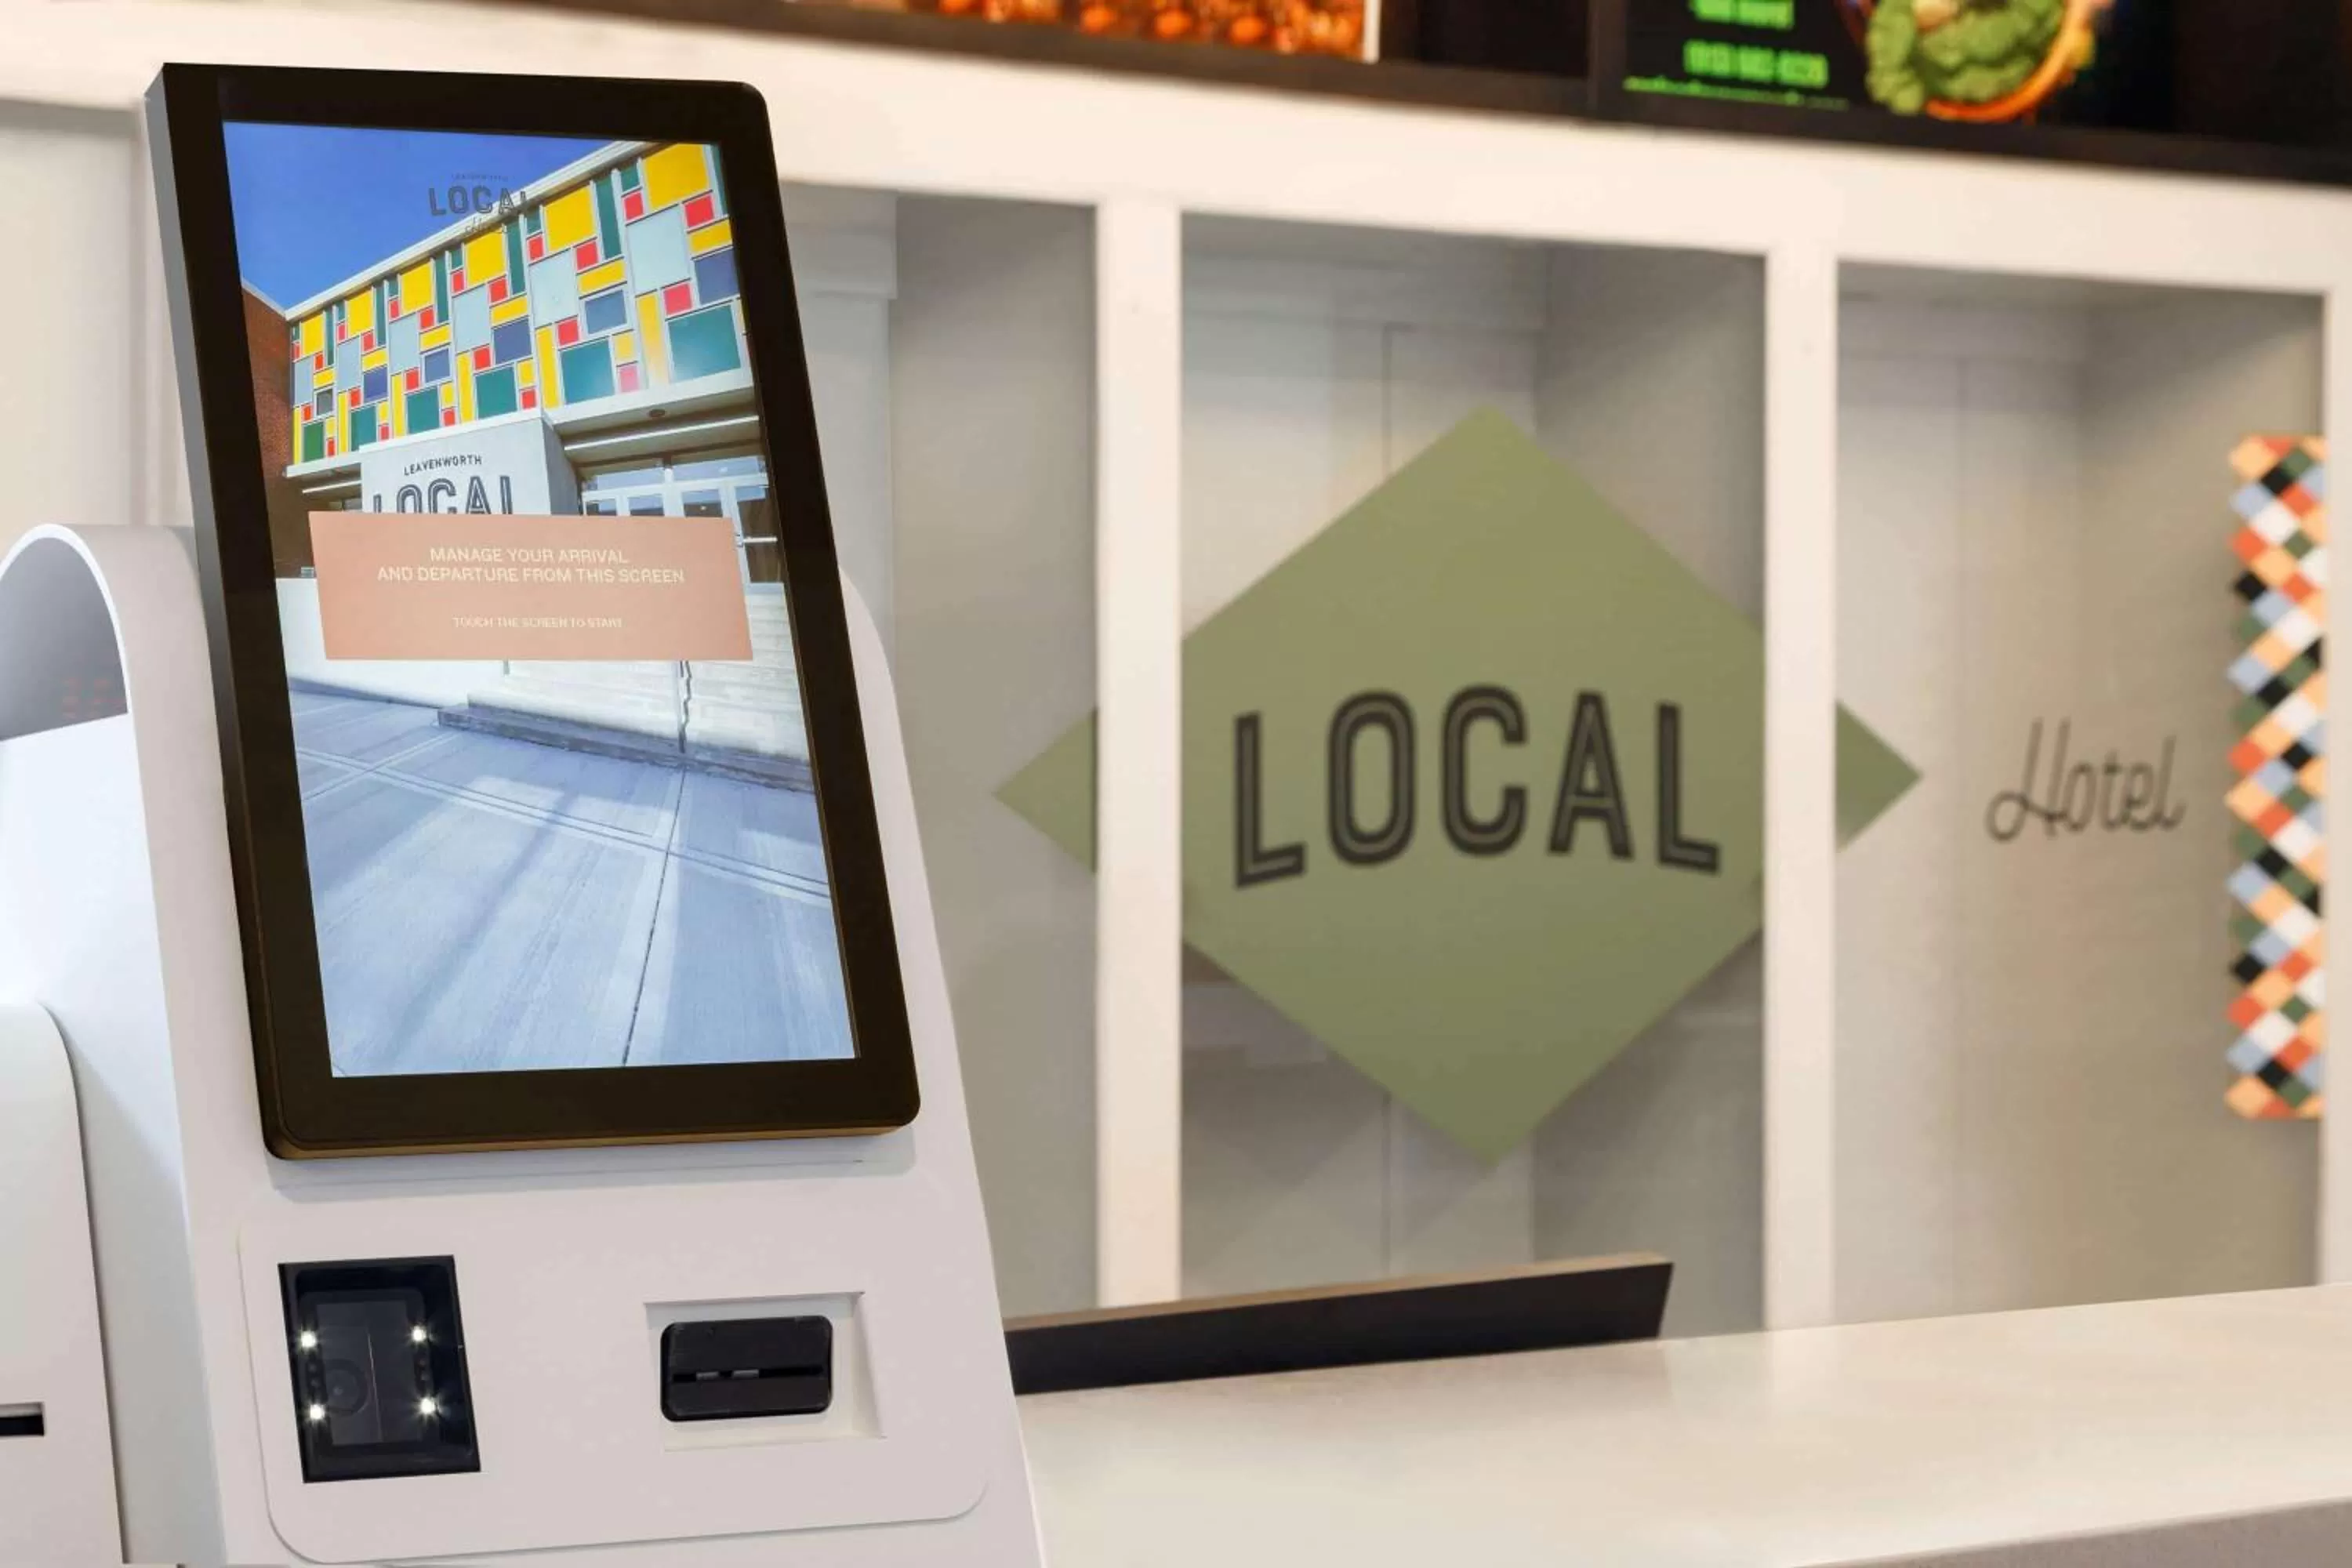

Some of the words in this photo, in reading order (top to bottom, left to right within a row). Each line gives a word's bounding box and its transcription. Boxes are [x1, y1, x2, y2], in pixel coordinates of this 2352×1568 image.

[403, 454, 482, 477] LEAVENWORTH
[430, 547, 503, 563] MANAGE
[506, 548, 555, 564] YOUR
[557, 549, 630, 565] ARRIVAL
[377, 567, 413, 583] AND
[418, 567, 520, 583] DEPARTURE
[524, 568, 572, 583] FROM
[575, 568, 615, 583] THIS
[618, 568, 684, 584] SCREEN
[1233, 684, 1720, 888] LOCAL
[1984, 716, 2189, 844] Hotel
